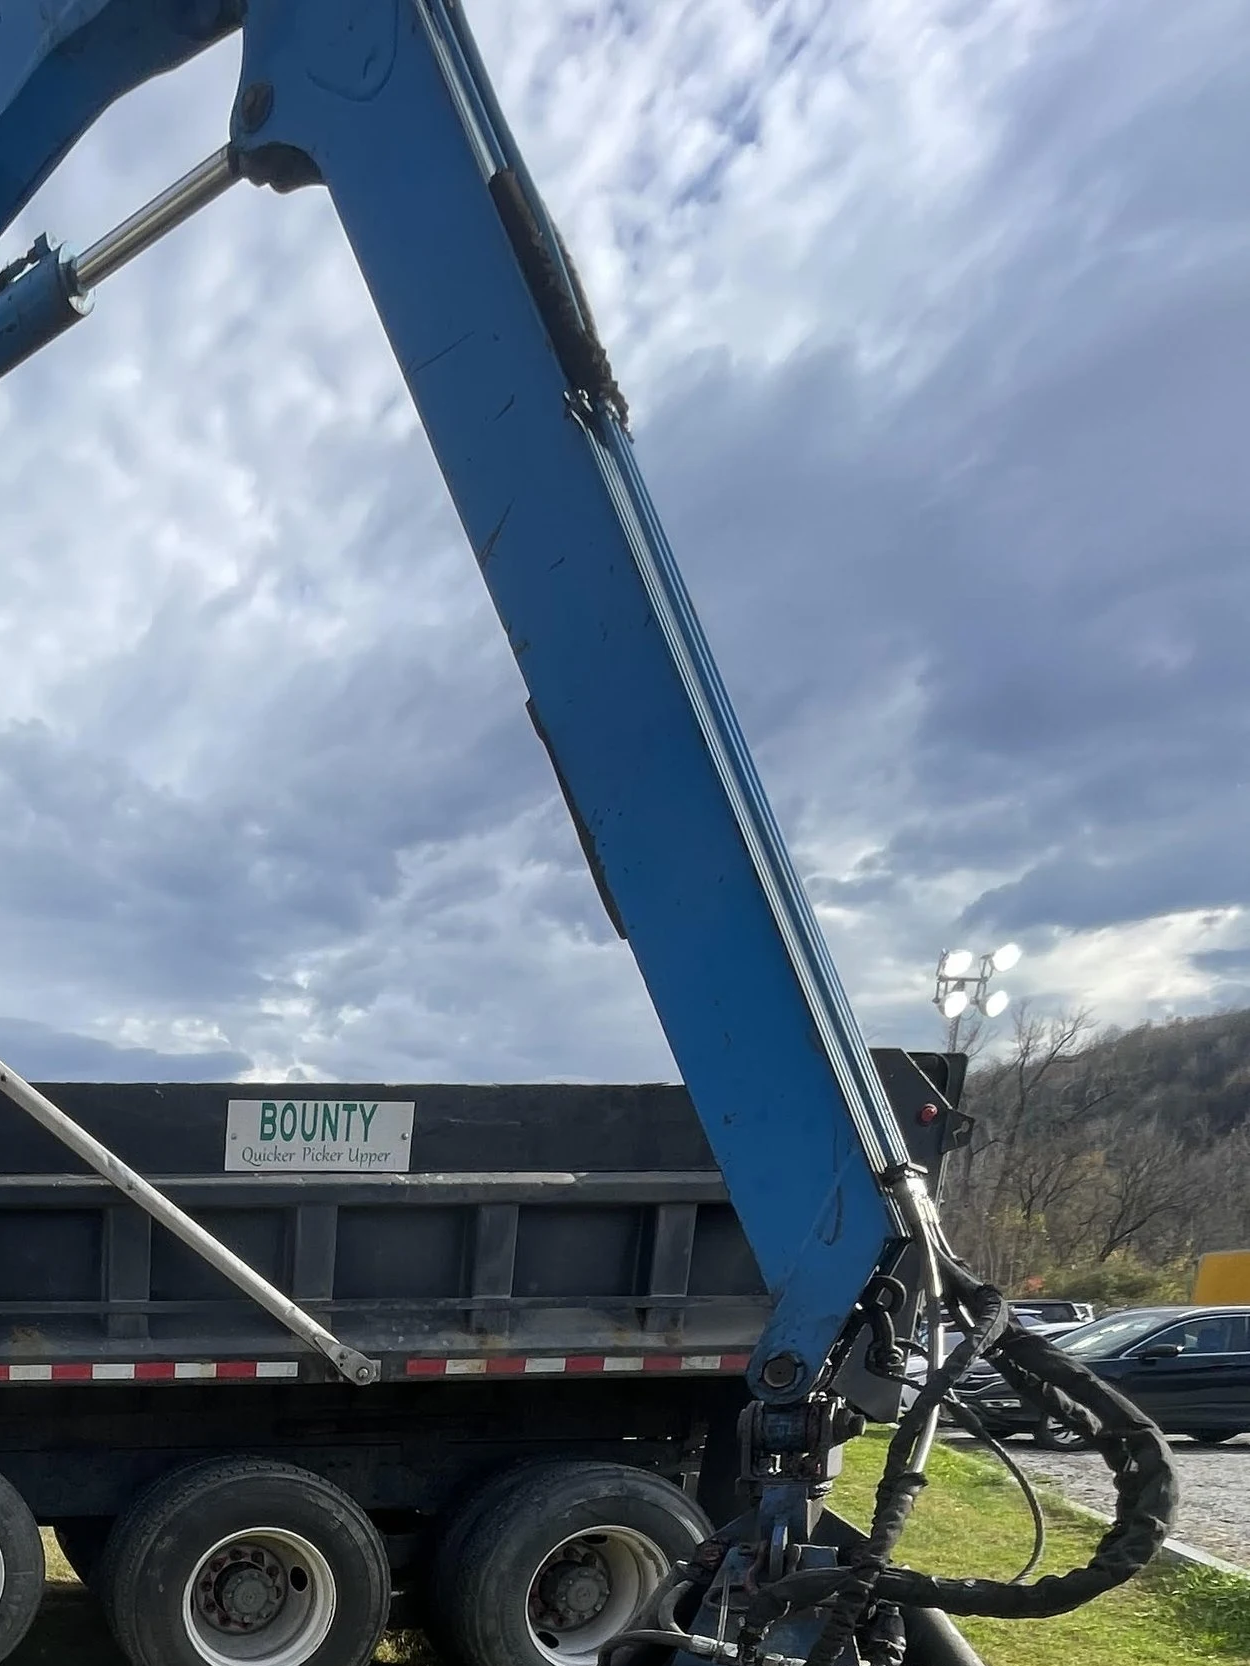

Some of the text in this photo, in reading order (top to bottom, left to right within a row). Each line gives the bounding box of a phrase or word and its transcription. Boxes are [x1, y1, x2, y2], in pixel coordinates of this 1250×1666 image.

[259, 1102, 379, 1142] BOUNTY
[242, 1146, 391, 1168] Quicker Picker Upper
